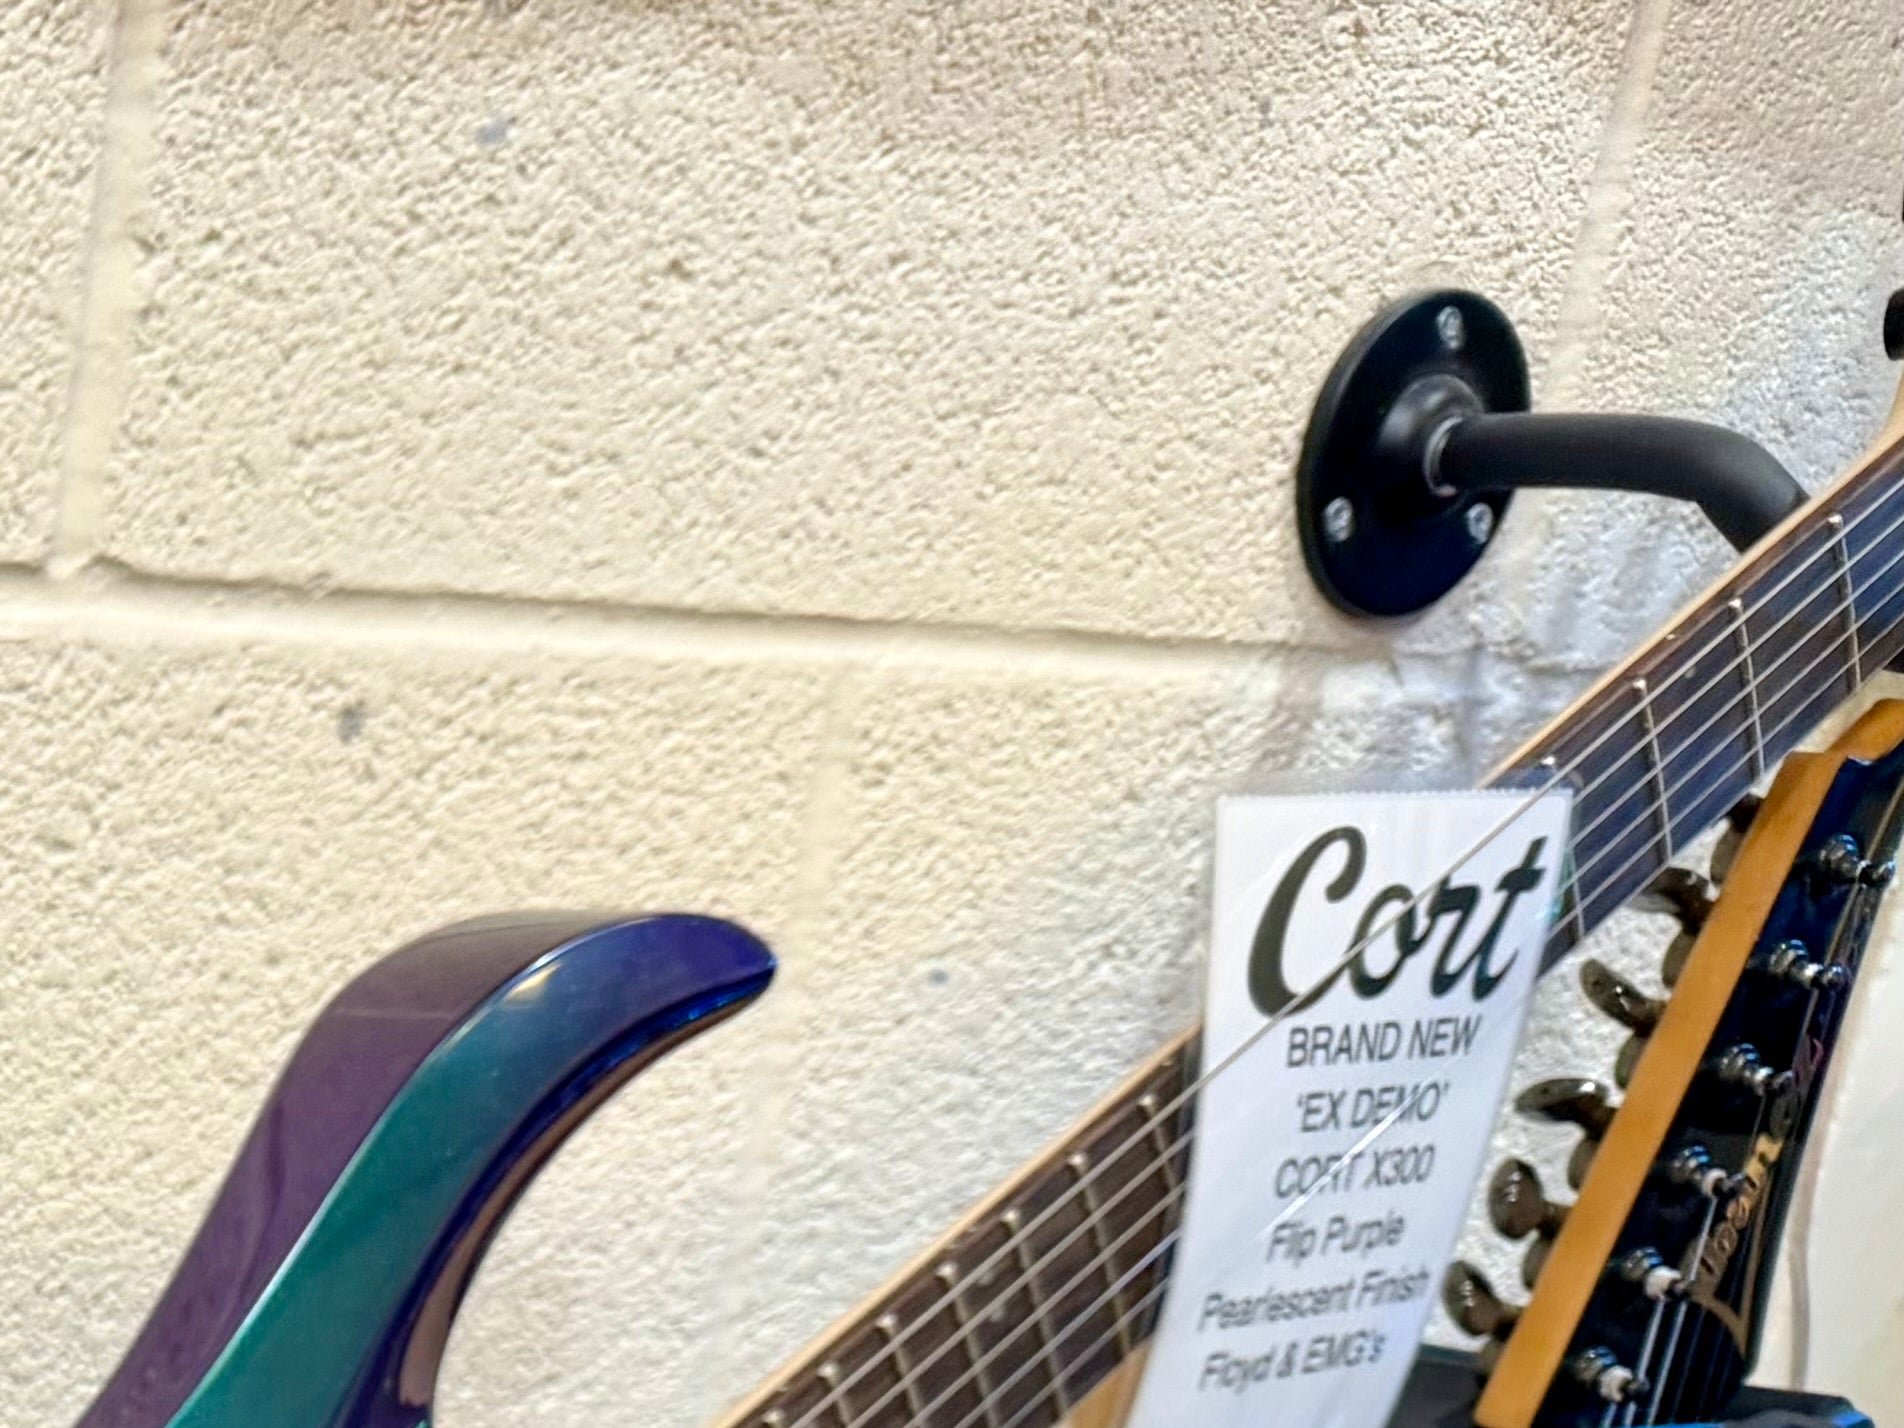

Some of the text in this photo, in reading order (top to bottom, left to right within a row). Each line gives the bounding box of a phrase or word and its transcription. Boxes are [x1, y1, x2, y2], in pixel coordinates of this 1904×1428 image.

[1247, 825, 1548, 1019] Cort
[1286, 1013, 1483, 1069] BRAND NEW
[1275, 1144, 1436, 1199] CORT X300
[1266, 1209, 1405, 1266] Flip Purple
[1198, 1265, 1430, 1333] Pearlescent Finish
[1198, 1344, 1276, 1393] Floyd
